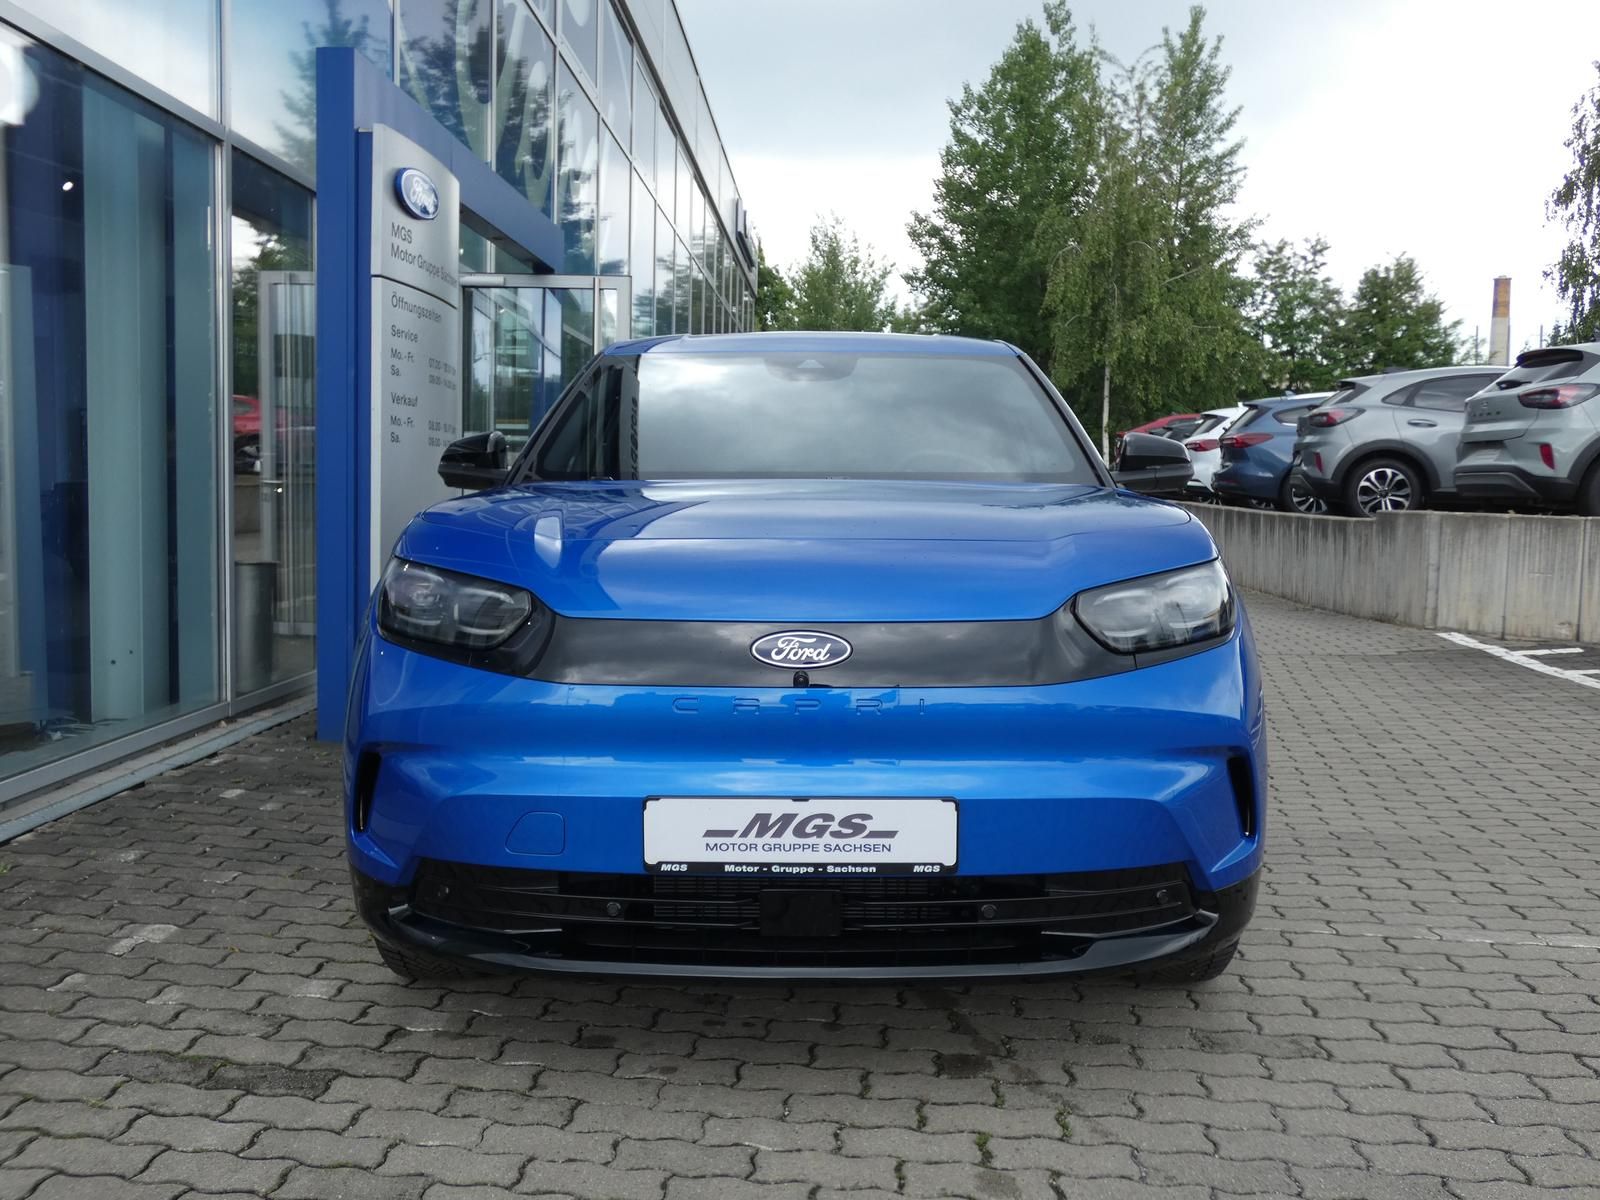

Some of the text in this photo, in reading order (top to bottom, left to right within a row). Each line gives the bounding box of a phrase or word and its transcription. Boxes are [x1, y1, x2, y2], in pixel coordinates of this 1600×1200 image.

[391, 222, 412, 244] MGS
[391, 243, 416, 265] Motor
[417, 254, 440, 278] Gruppe
[391, 325, 418, 343] Service
[391, 392, 418, 407] Verkauf
[770, 636, 832, 662] Ford
[671, 697, 926, 716] CAPRI
[738, 813, 874, 839] MGS
[705, 842, 891, 853] MOTOR GRUPPE SACHSEN
[660, 864, 688, 872] MGS
[724, 864, 760, 873] Motor
[771, 865, 814, 875] Gruppe
[827, 864, 877, 873] Sachsen
[913, 865, 940, 873] MGS
